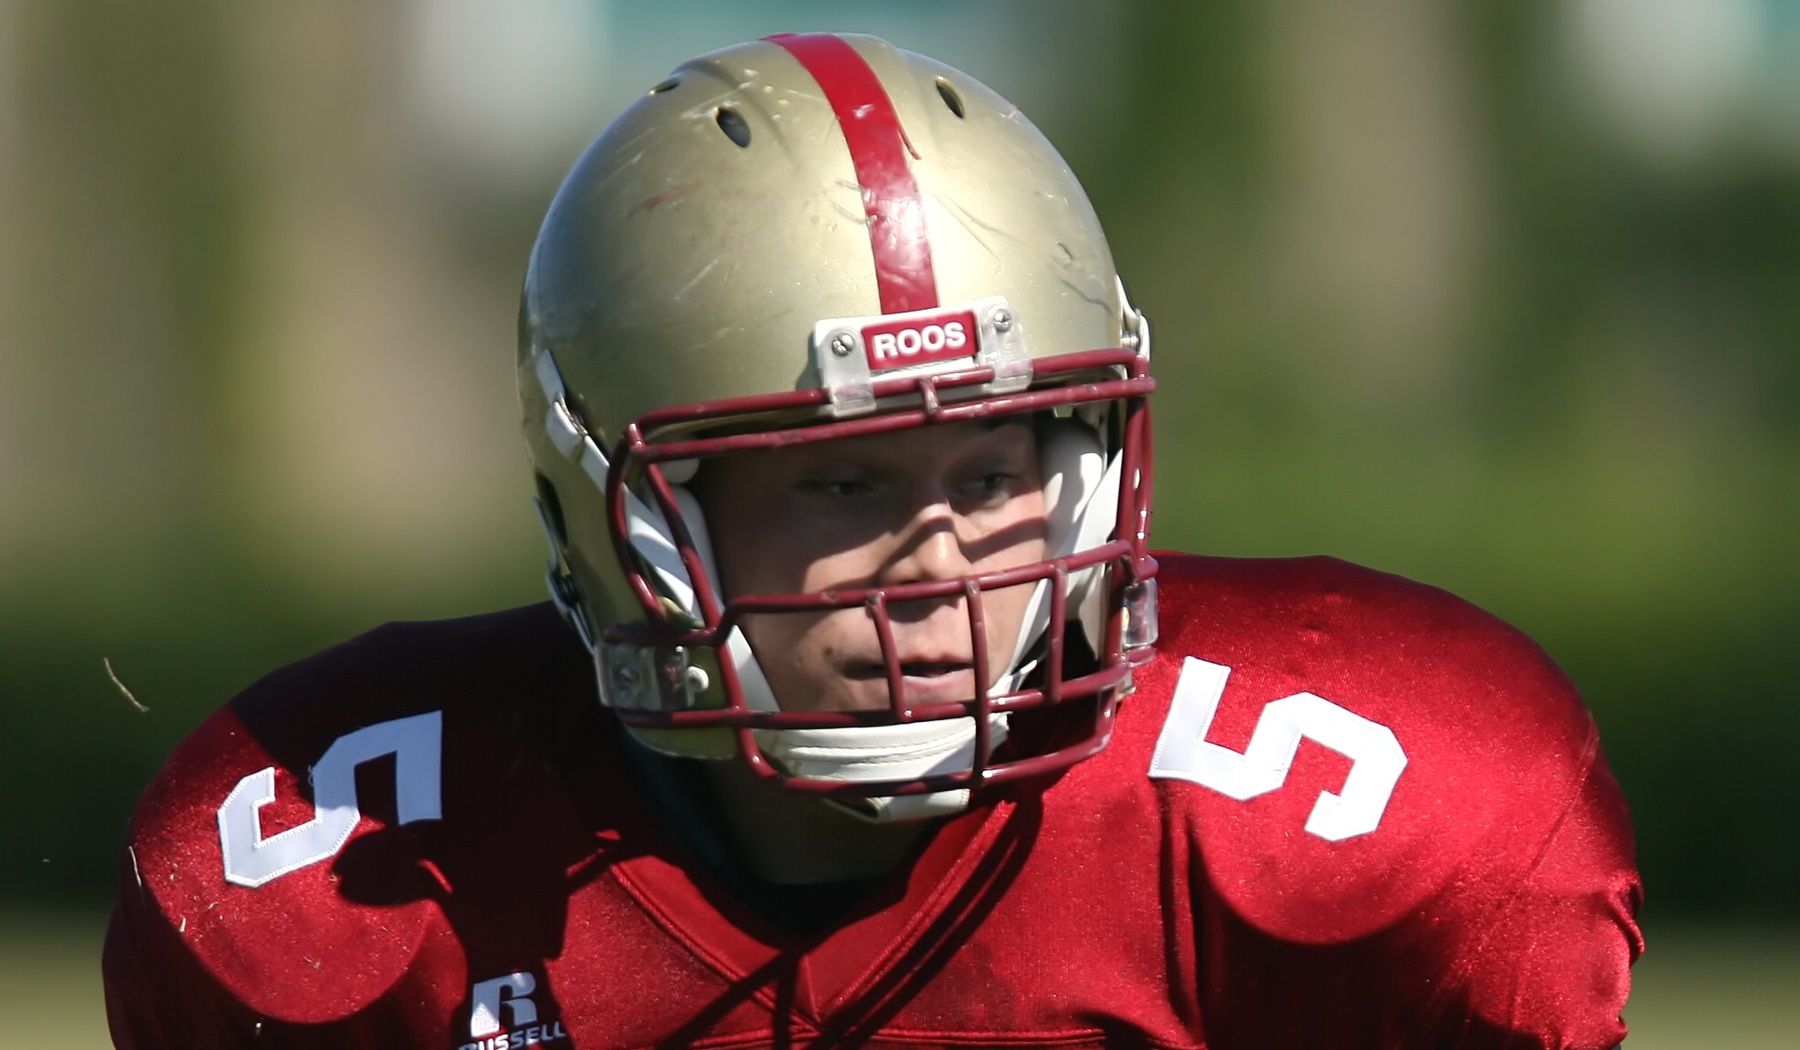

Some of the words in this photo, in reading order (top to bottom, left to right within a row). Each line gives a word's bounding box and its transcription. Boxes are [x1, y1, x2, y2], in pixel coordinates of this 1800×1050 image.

[873, 322, 966, 360] ROOS
[217, 710, 442, 888] 5
[1148, 656, 1408, 842] 5
